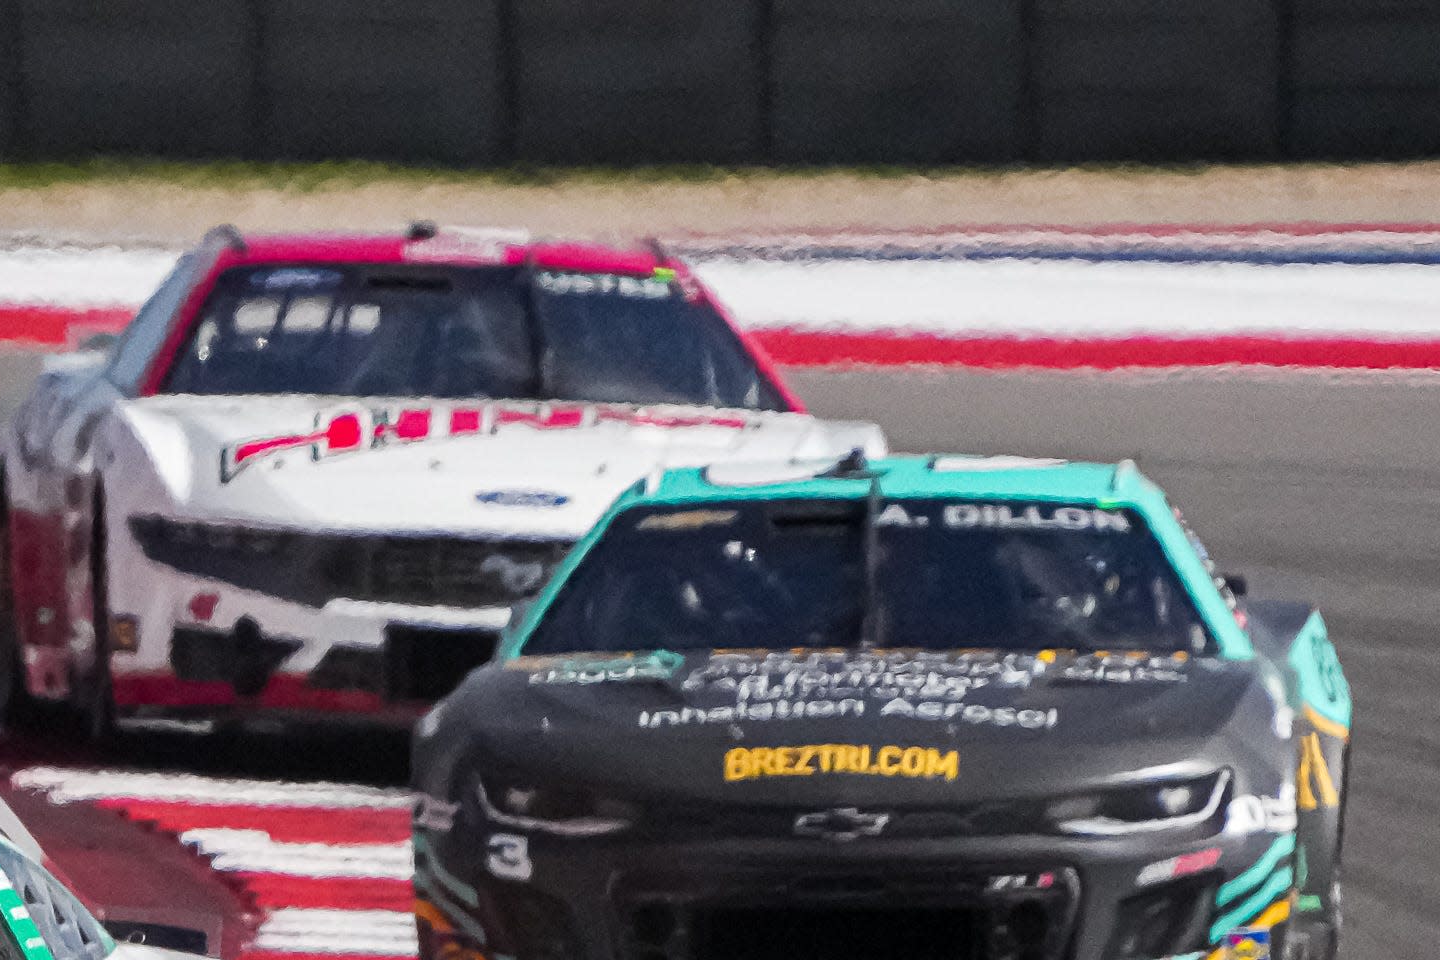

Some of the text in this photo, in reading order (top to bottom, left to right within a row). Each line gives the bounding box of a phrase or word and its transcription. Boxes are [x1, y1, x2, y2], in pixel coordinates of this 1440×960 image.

[943, 504, 1130, 534] DILLON
[879, 697, 1059, 731] Aerosol
[723, 743, 960, 782] BREZTRI.COM
[486, 832, 534, 881] 3
